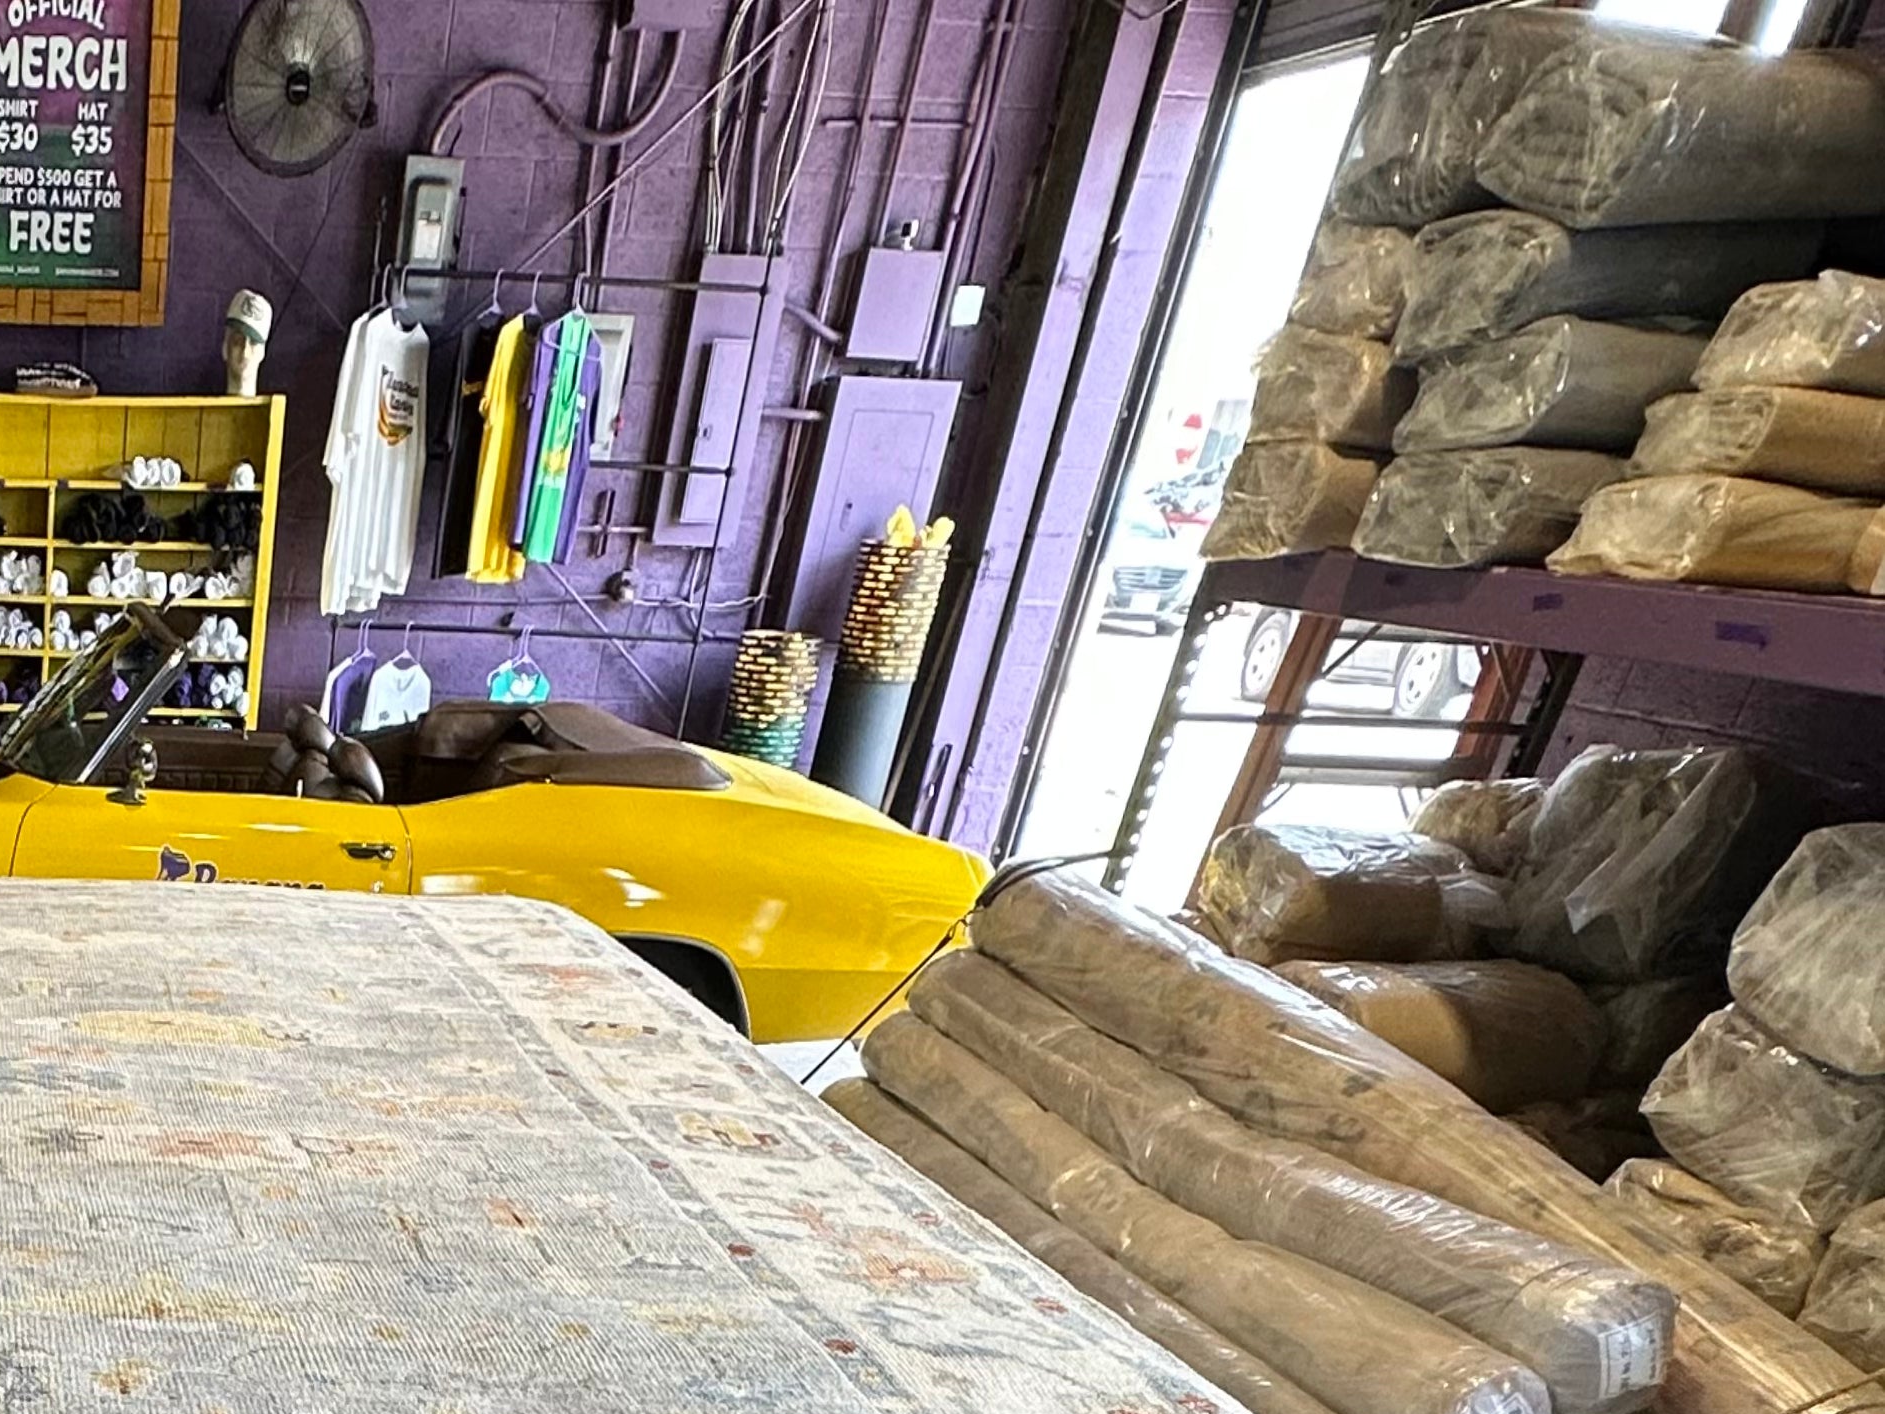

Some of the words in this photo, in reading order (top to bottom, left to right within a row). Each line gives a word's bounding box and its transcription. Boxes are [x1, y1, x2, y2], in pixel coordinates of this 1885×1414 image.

[8, 0, 104, 30] OFFICIAL
[78, 102, 108, 121] HAT
[71, 123, 112, 157] $35
[37, 166, 71, 187] $500
[74, 169, 104, 188] GET
[107, 171, 117, 188] A
[27, 187, 47, 206] OR
[50, 189, 60, 207] A
[63, 189, 92, 208] HAT
[94, 191, 122, 208] FOR
[9, 209, 95, 254] FREE
